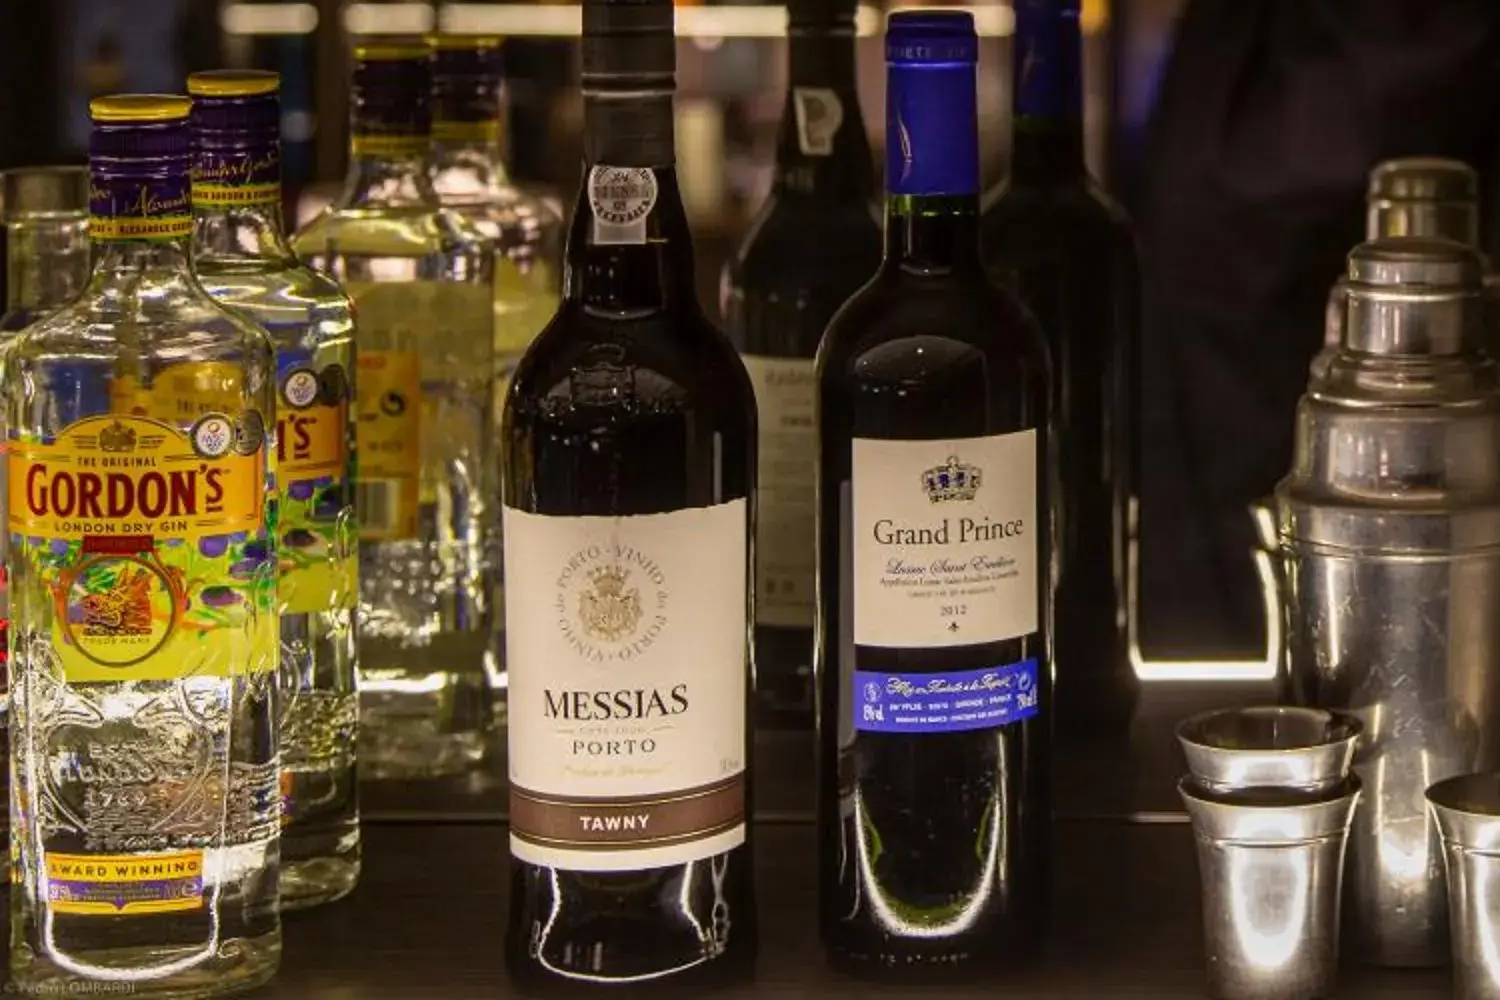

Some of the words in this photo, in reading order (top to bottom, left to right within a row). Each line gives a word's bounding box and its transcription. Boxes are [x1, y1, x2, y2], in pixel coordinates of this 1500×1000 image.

[77, 457, 98, 467] THE
[102, 456, 157, 468] ORIGINAL
[27, 463, 224, 519] GORDON'S
[55, 521, 116, 534] LONDON
[123, 521, 154, 534] DRY
[160, 520, 188, 533] GIN
[873, 518, 949, 546] Grand
[959, 516, 1024, 544] Prince
[557, 545, 600, 589] PORTO
[615, 545, 665, 586] VINHO
[940, 604, 967, 617] 2012
[543, 683, 689, 721] MESSIAS
[572, 738, 657, 755] PORTO
[580, 814, 650, 831] TAWNY
[51, 863, 107, 877] AWARD
[115, 861, 198, 876] WINNING
